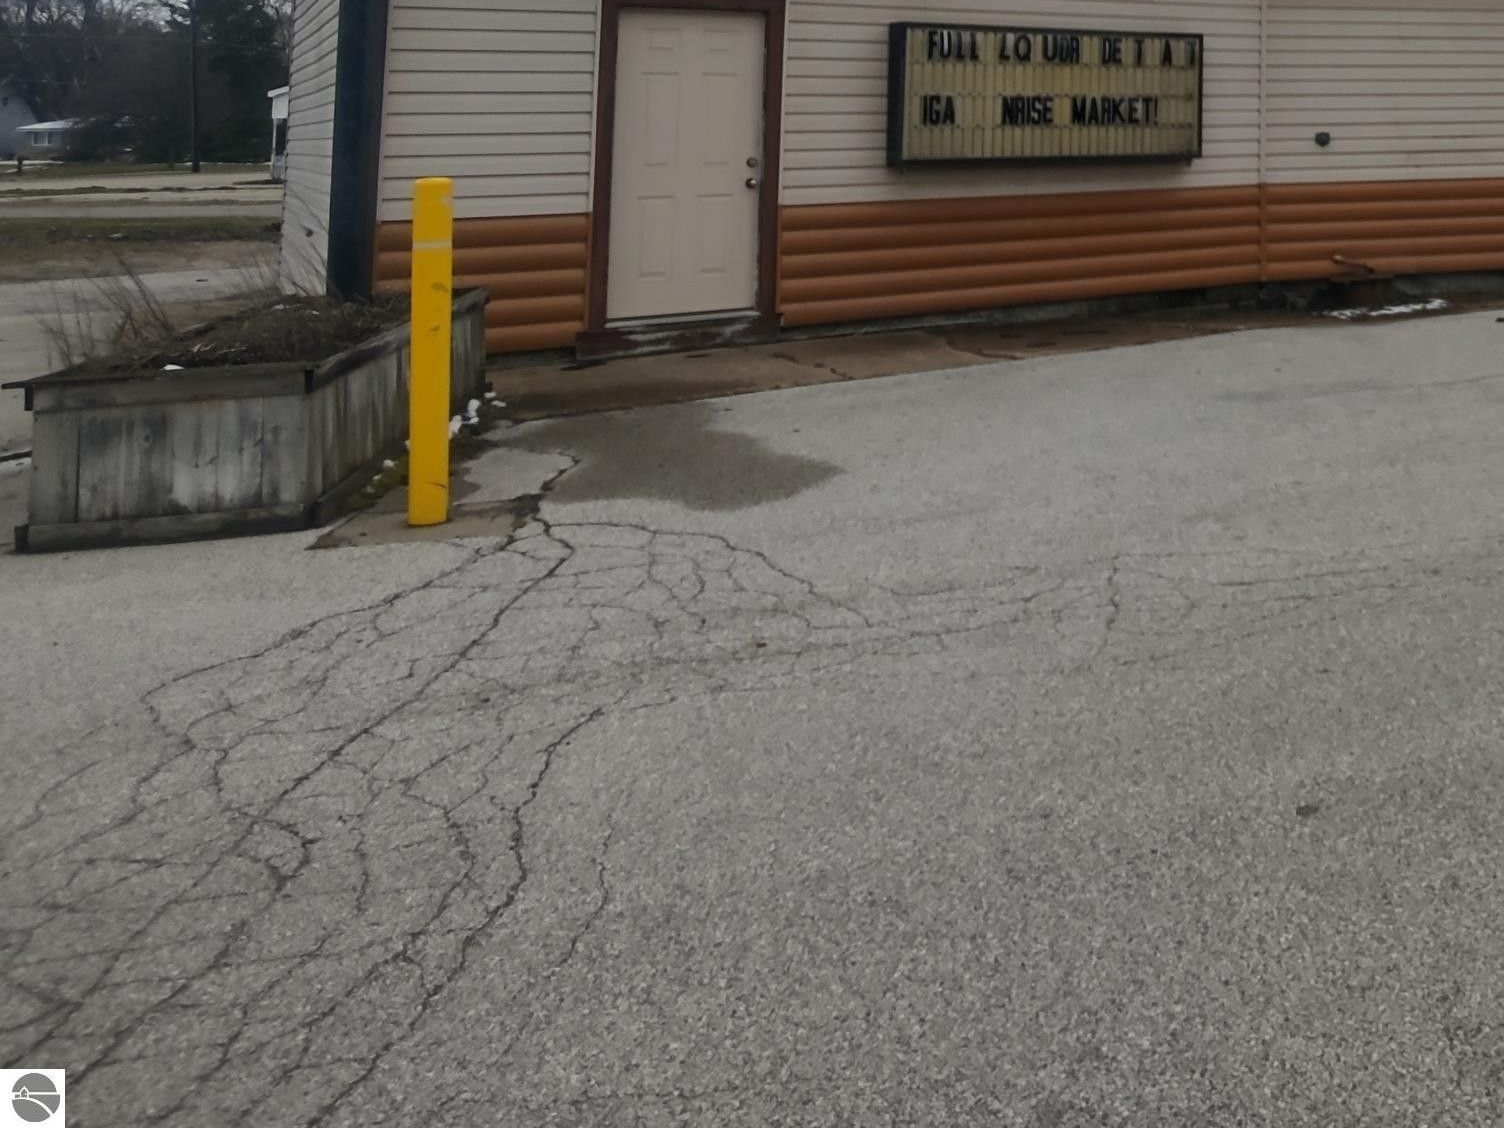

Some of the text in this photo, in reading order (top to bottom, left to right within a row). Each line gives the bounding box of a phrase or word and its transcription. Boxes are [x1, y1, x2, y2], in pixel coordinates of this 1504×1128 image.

[927, 30, 979, 62] FULL
[922, 94, 956, 126] IGA
[1071, 94, 1159, 125] MARKET!
